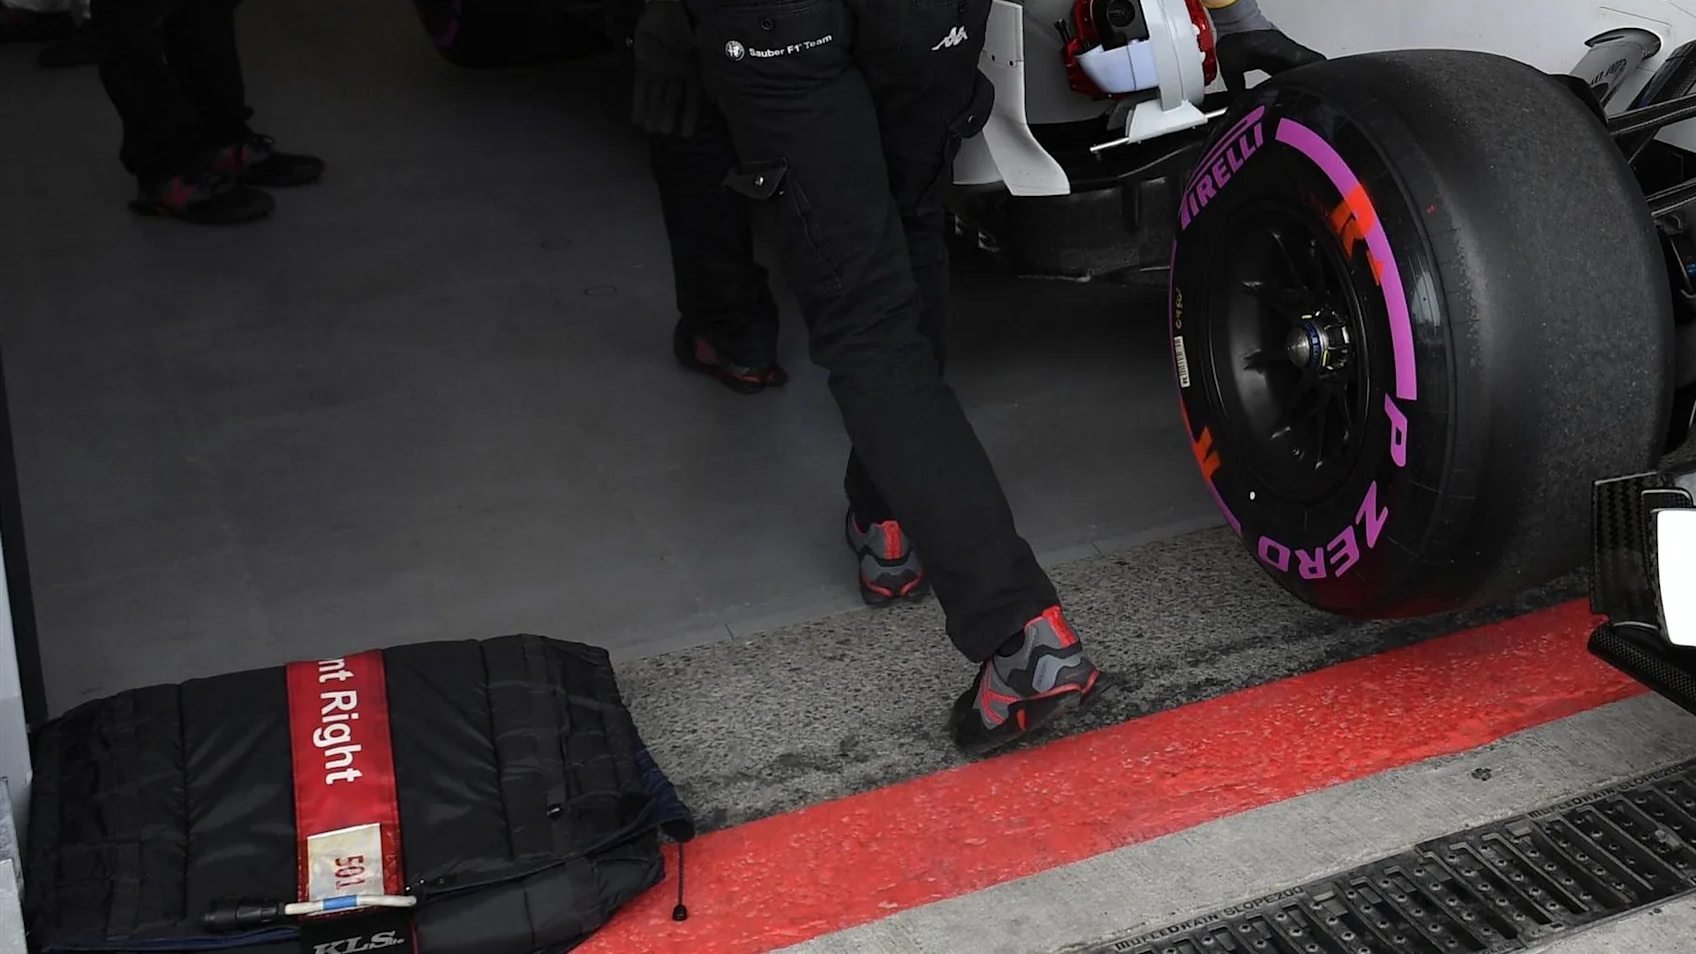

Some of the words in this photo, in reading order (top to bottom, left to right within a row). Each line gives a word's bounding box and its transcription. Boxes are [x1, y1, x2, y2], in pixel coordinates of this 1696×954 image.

[748, 47, 785, 58] Sauber
[802, 34, 833, 50] Team
[1180, 104, 1266, 232] PIRELLI
[1384, 392, 1408, 468] P
[1257, 480, 1389, 580] ZERO
[312, 690, 363, 786] Right
[1222, 884, 1305, 917] SLOPE200
